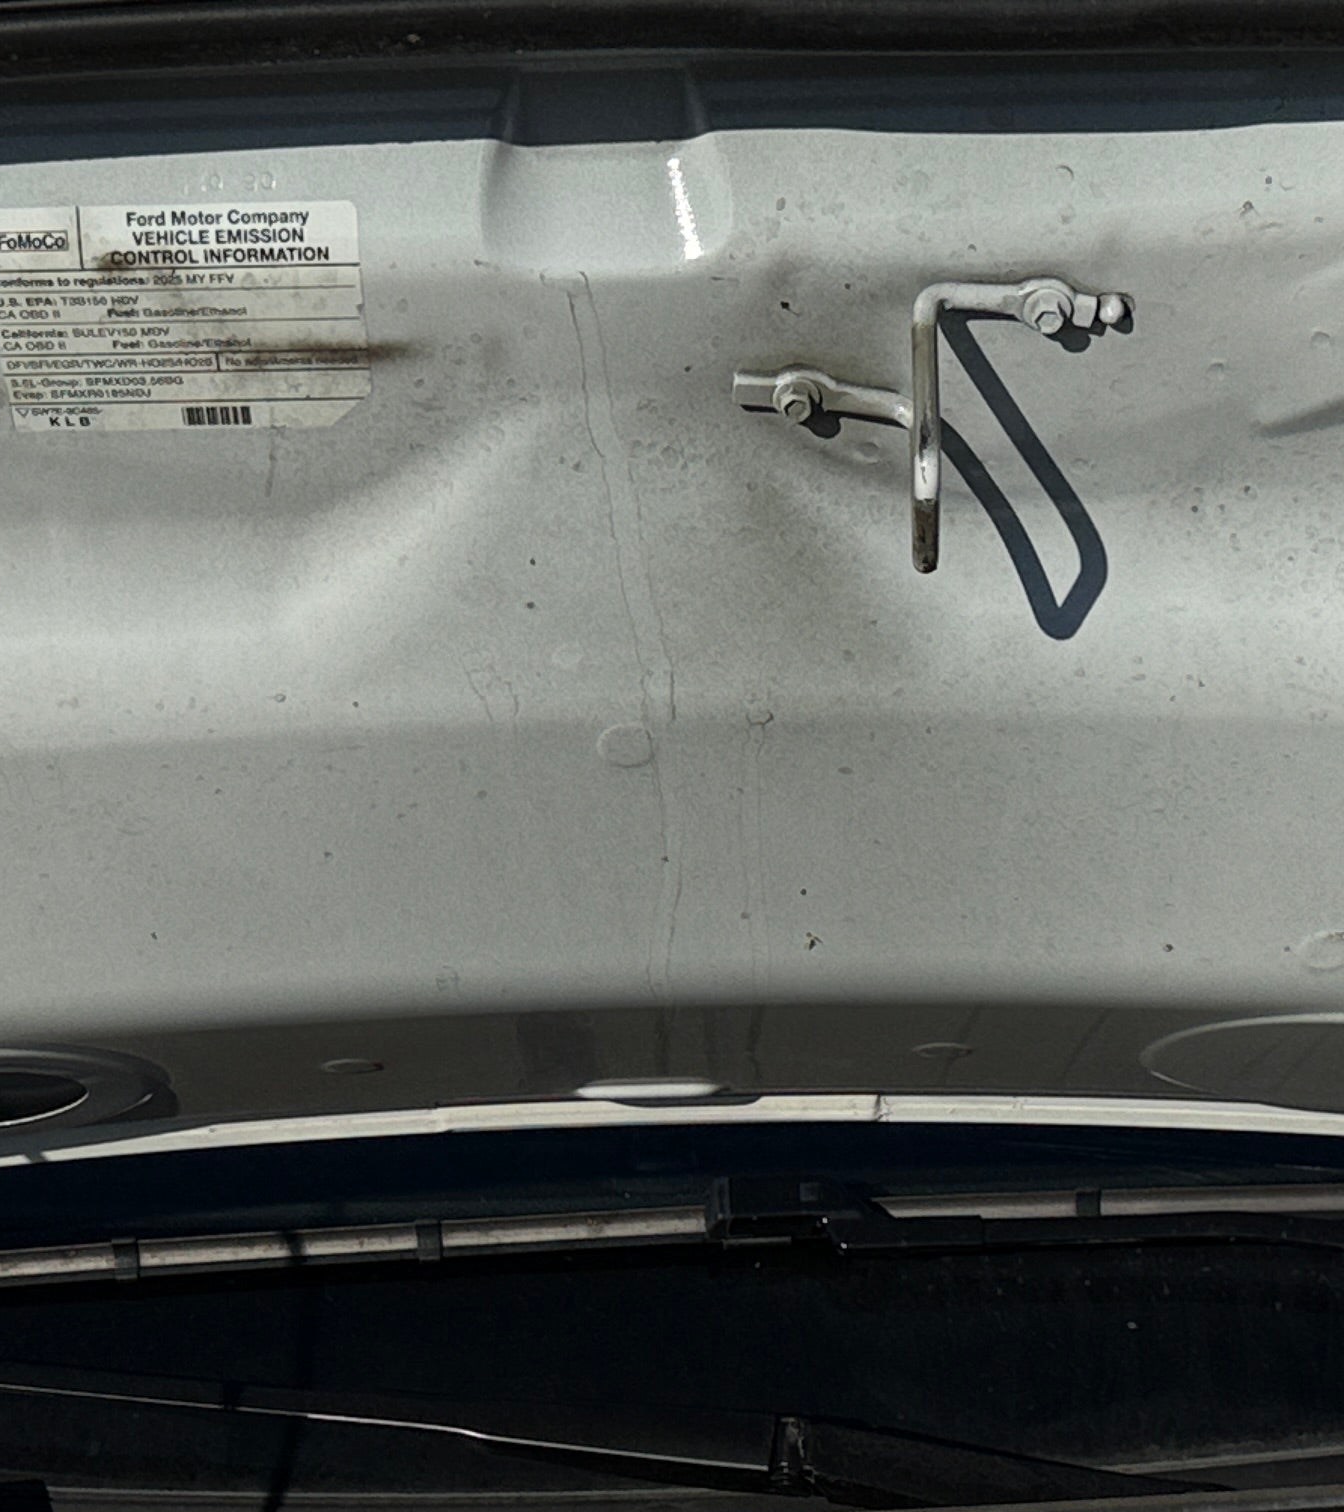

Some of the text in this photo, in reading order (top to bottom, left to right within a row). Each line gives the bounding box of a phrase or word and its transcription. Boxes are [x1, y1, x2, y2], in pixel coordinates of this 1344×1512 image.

[127, 208, 309, 227] Ford Motor Company
[132, 227, 305, 246] VEHICLE EMISSION
[110, 246, 330, 266] CONTROL INFORMATION
[57, 277, 70, 287] to
[186, 273, 205, 284] MY
[209, 273, 235, 284] FFV
[3, 341, 22, 351] CA
